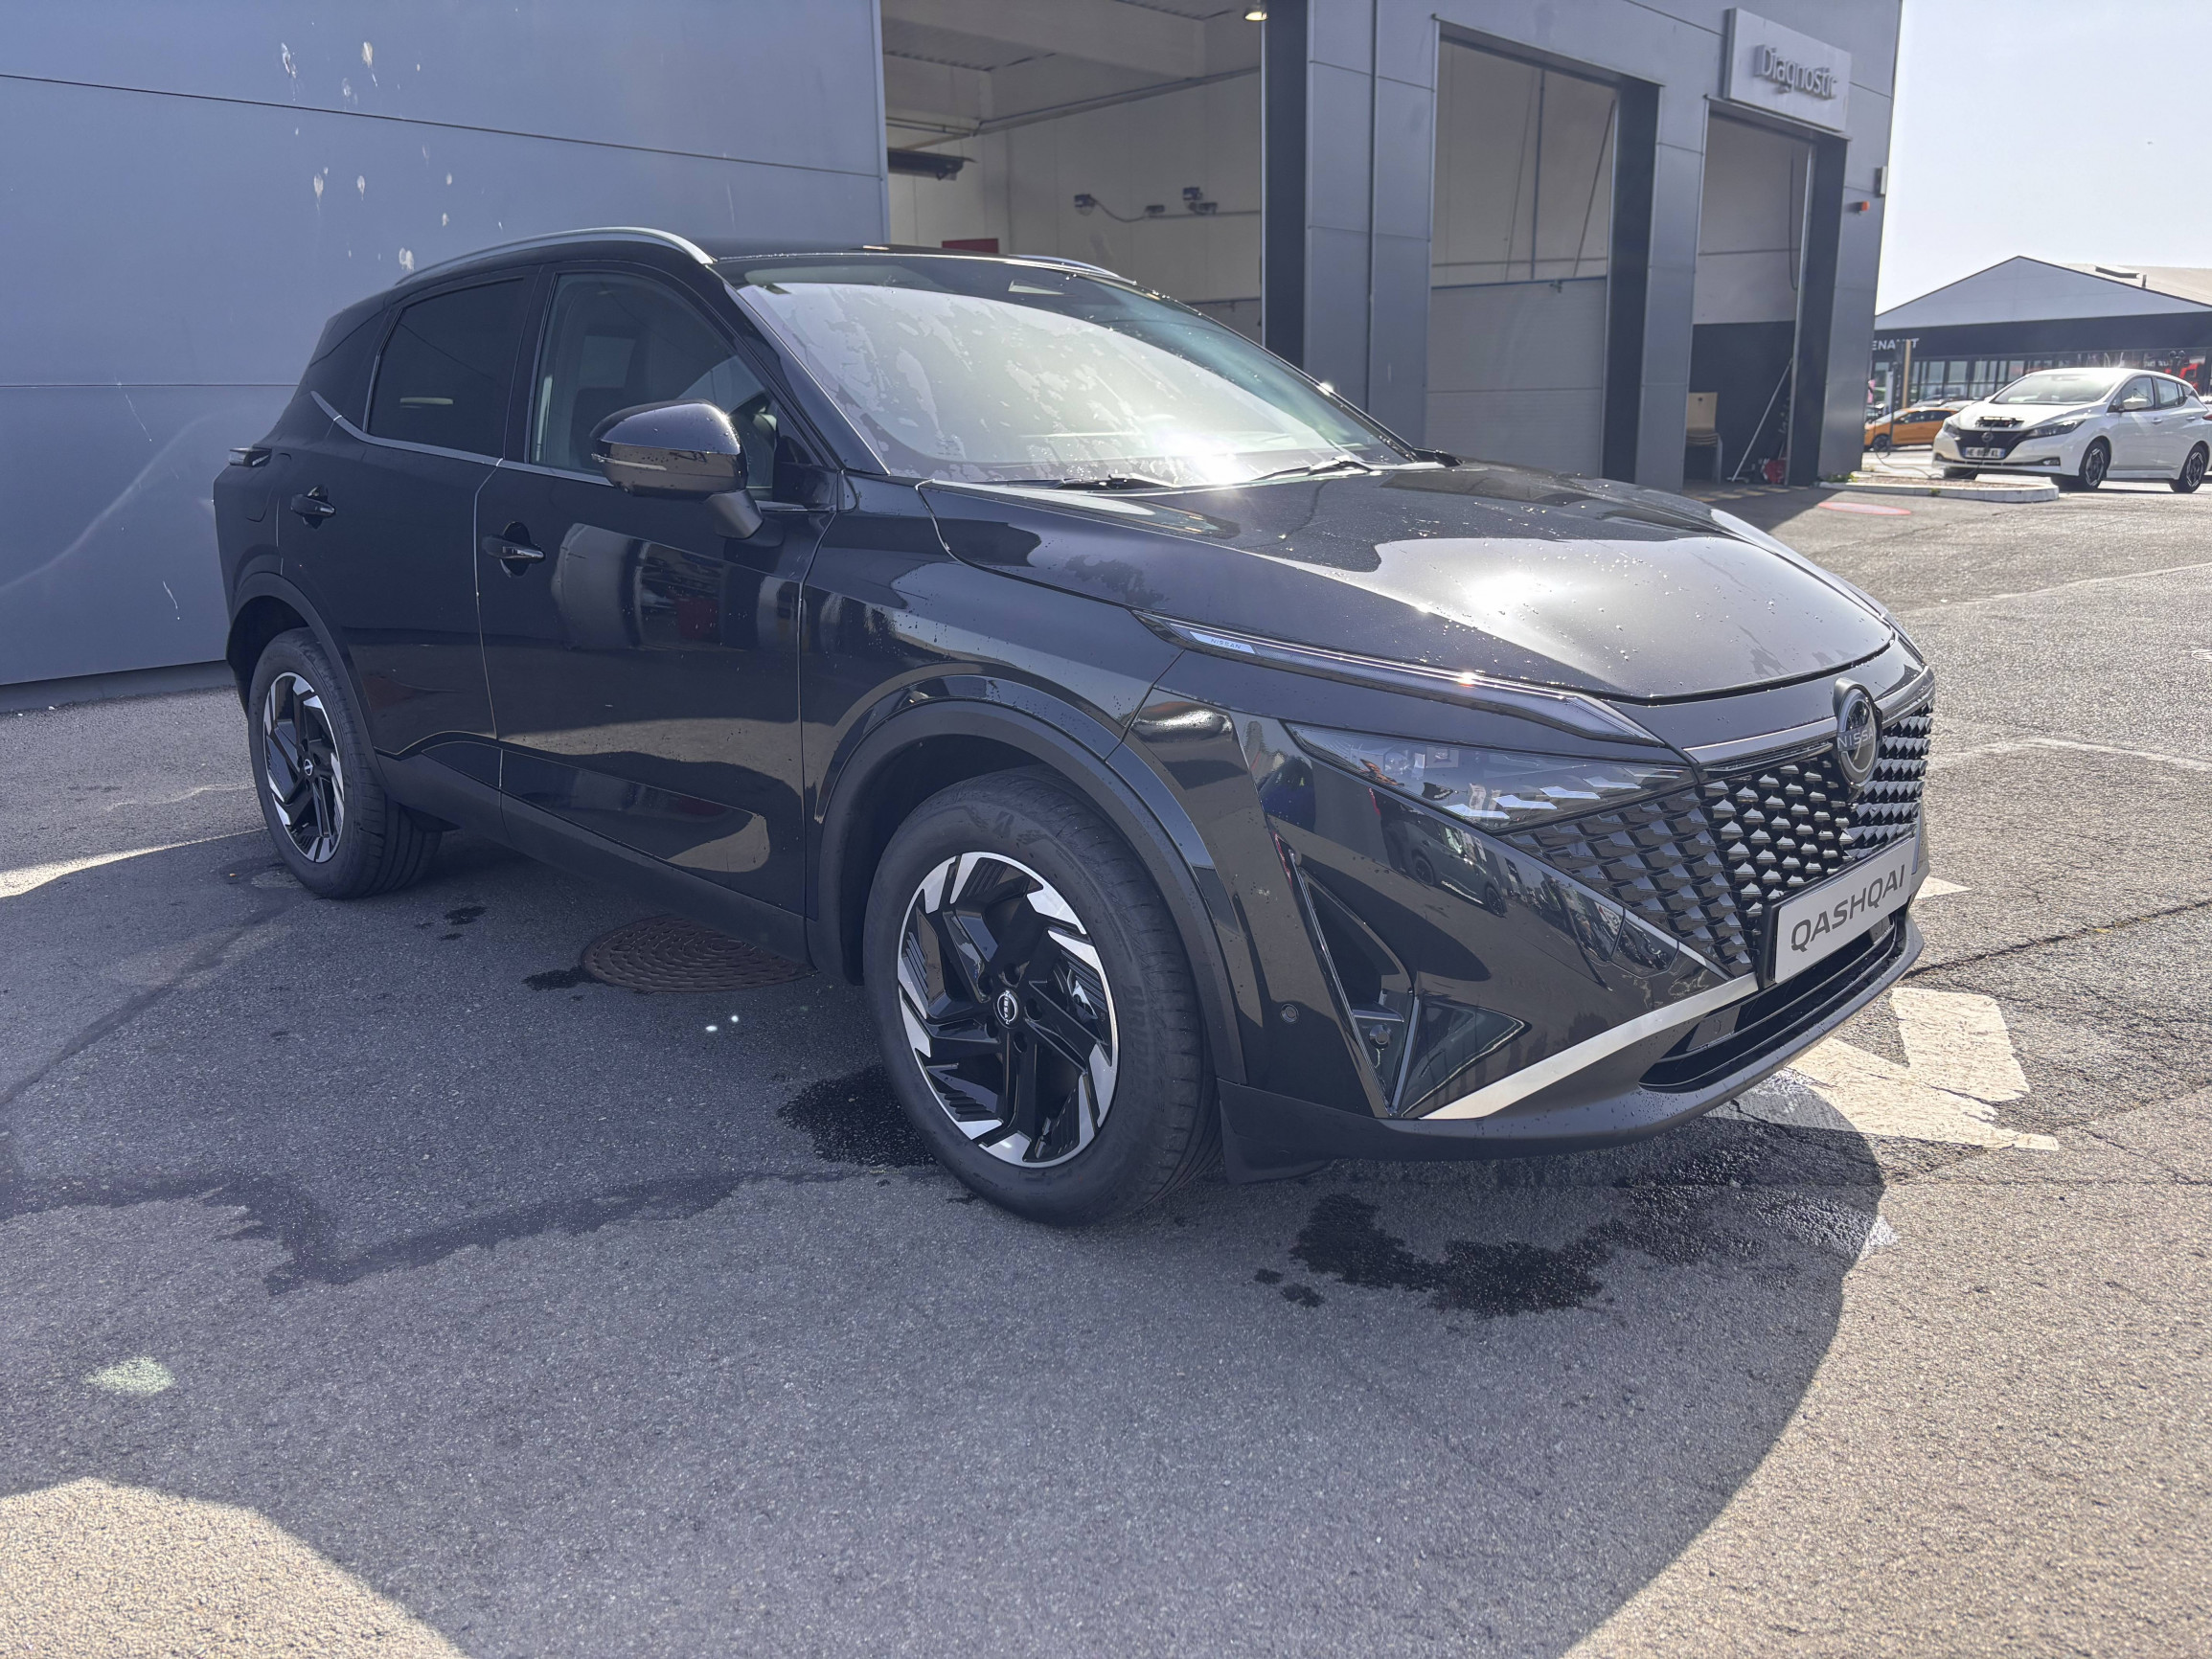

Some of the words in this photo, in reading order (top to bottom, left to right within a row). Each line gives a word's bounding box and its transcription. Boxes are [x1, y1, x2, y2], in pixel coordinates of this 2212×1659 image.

[1872, 338, 1919, 351] ENAT
[1836, 727, 1874, 749] NISSA
[1790, 864, 1905, 953] QASHQAI
